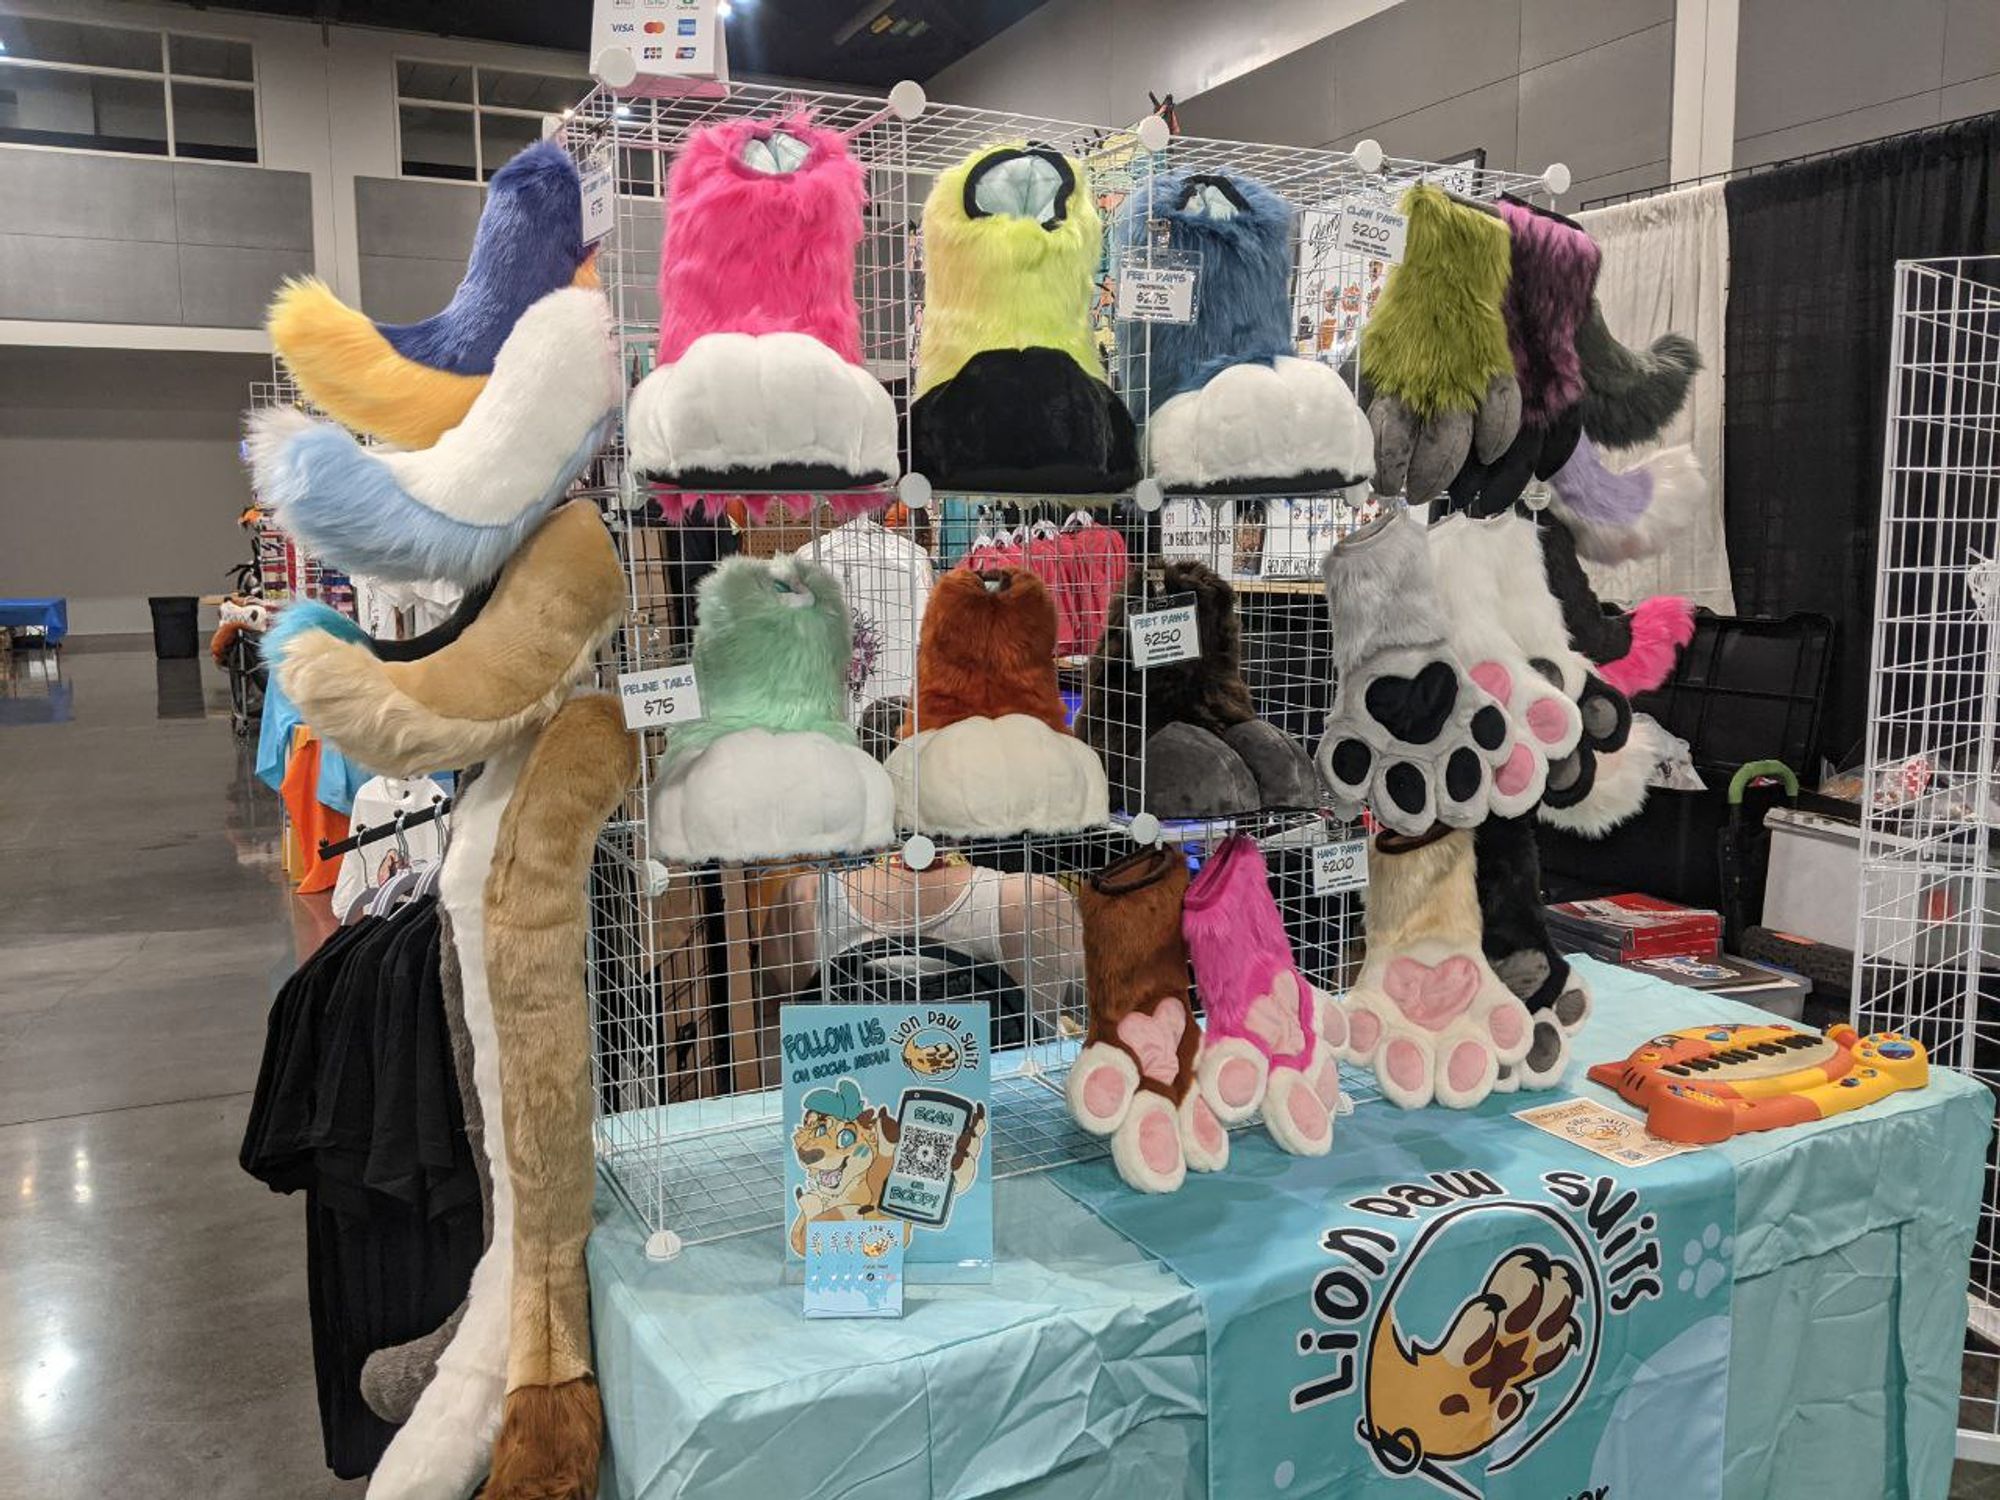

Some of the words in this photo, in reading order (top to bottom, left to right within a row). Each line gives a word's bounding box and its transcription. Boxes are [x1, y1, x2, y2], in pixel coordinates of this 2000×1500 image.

[611, 23, 634, 32] VISA
[1347, 205, 1374, 220] CLAW
[1352, 221, 1391, 242] $200
[1126, 270, 1151, 281] FEET
[1156, 271, 1187, 283] PAWS
[1136, 291, 1169, 305] $275
[1134, 616, 1158, 631] FEET
[1161, 611, 1190, 625] PAWS
[1143, 628, 1181, 647] $250
[623, 680, 660, 696] FELINE
[663, 675, 694, 690] TAILS
[643, 697, 675, 716] $75
[1317, 846, 1339, 860] HAND
[1340, 842, 1364, 856] PAWS
[1322, 856, 1354, 874] $200
[782, 1022, 855, 1064] FOLLOW
[857, 1017, 886, 1049] US
[792, 1067, 811, 1084] ON
[811, 1059, 852, 1080] SOCIAL
[914, 1106, 954, 1127] SCAN
[889, 1185, 941, 1209] BOOP!
